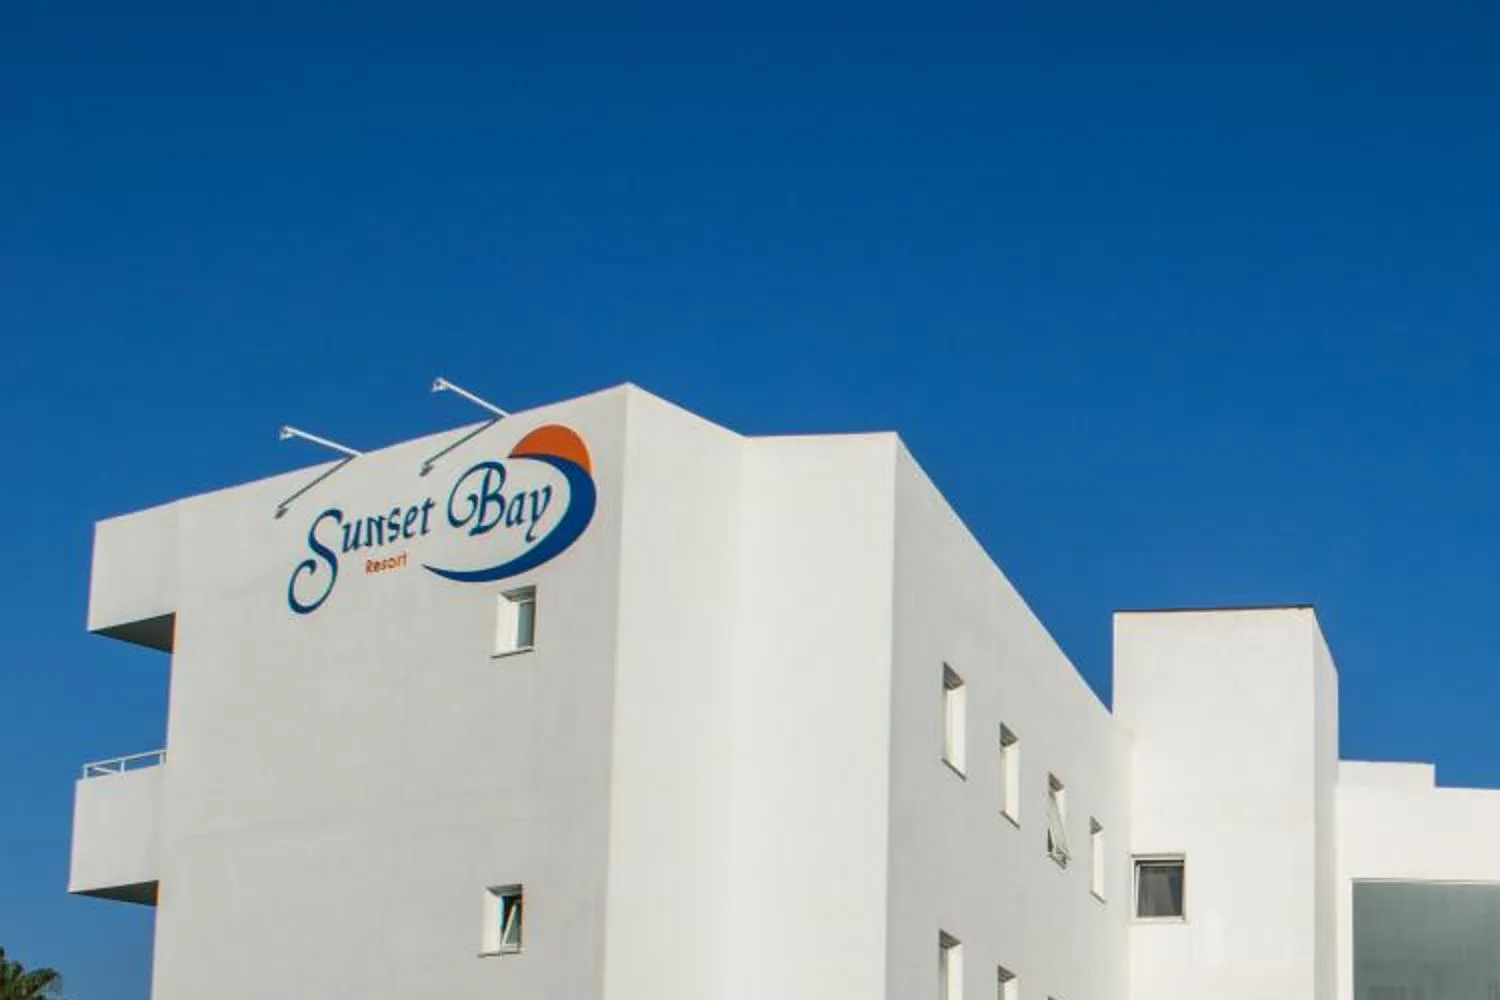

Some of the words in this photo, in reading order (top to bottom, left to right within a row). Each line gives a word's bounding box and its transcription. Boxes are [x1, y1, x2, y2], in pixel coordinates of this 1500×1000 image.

[287, 497, 436, 615] Sunset
[447, 460, 552, 542] Bay
[365, 551, 408, 575] Resort
